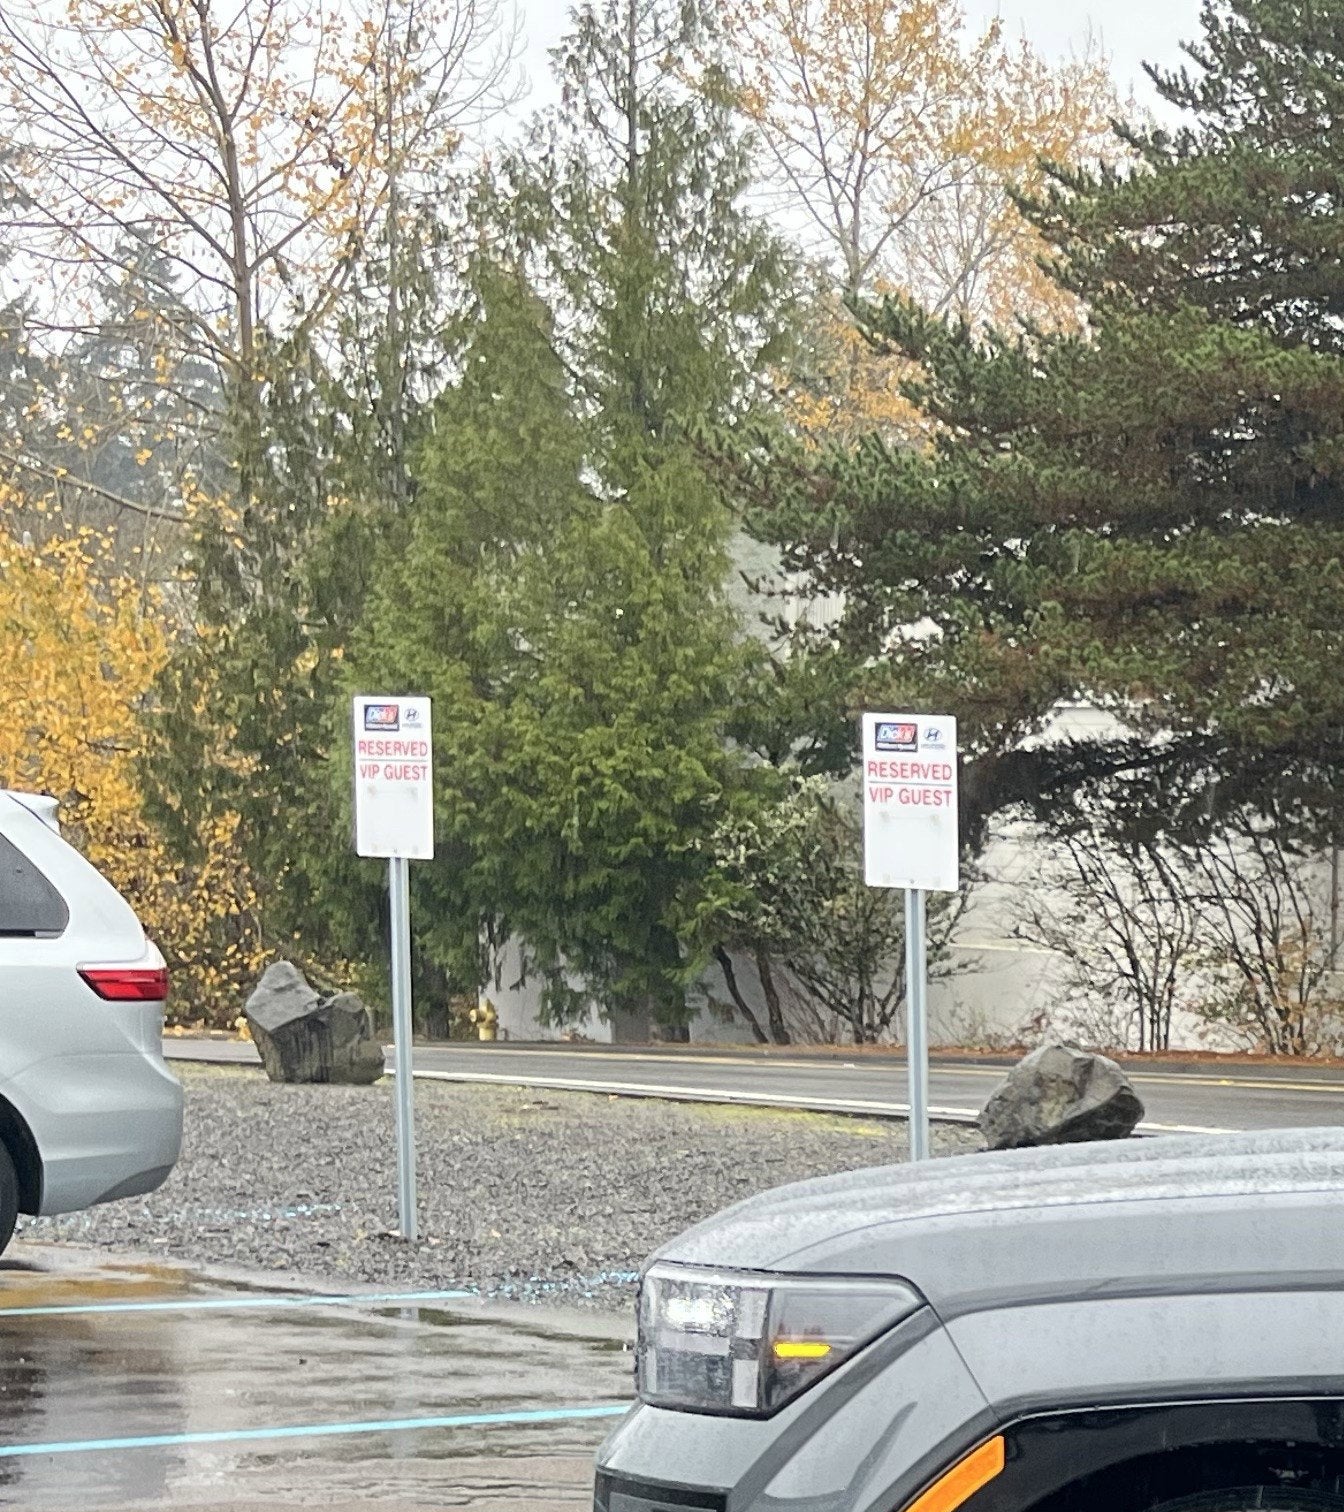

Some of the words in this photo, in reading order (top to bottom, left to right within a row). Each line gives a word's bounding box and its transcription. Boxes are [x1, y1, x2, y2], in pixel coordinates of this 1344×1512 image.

[358, 740, 428, 757] RESERVED
[360, 764, 380, 779] VIP
[383, 764, 428, 781] GUEST
[867, 760, 953, 781] RESERVED
[868, 787, 894, 803] VIP
[898, 788, 952, 807] GUEST
